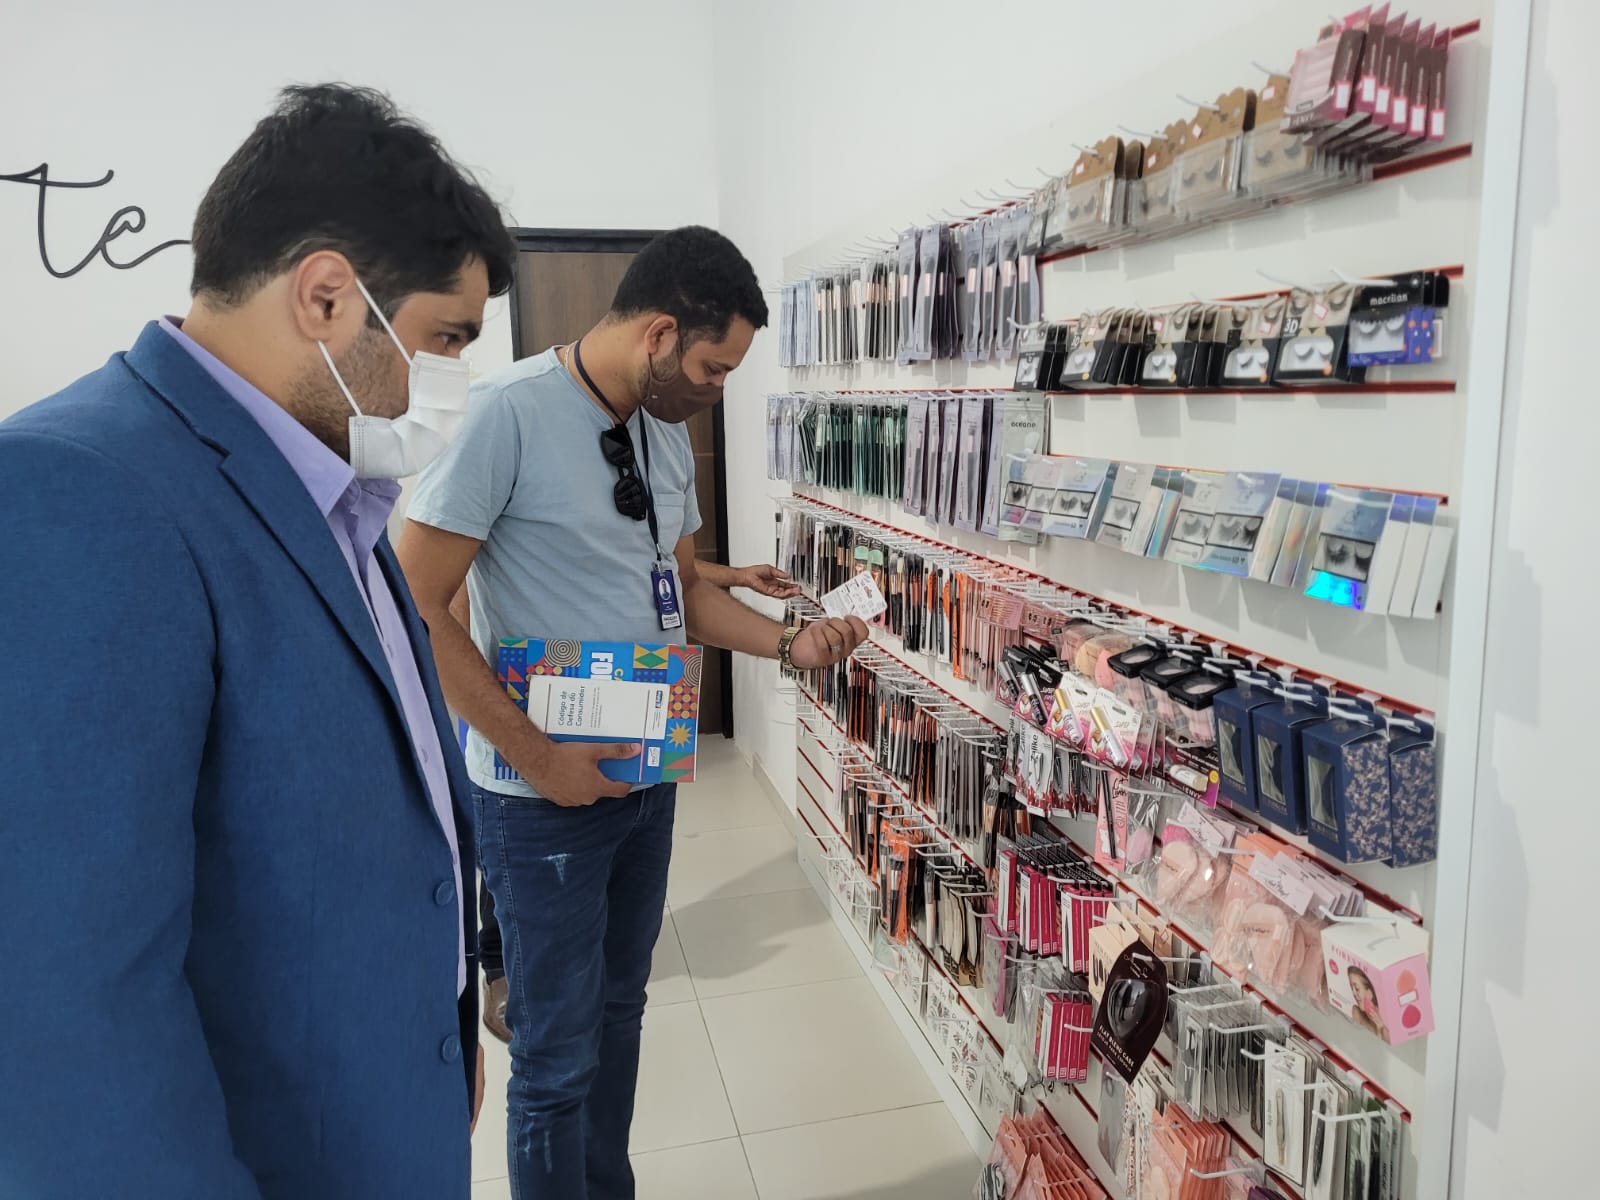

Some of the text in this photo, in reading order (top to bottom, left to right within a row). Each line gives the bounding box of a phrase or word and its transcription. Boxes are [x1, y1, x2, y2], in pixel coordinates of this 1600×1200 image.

[1370, 293, 1408, 306] macrilan
[558, 701, 566, 726] Código
[567, 701, 575, 726] Defesa
[576, 685, 586, 726] Consumidor
[1099, 1025, 1109, 1037] FLAT
[1109, 1036, 1122, 1053] BLEND
[1122, 1052, 1134, 1067] CASE
